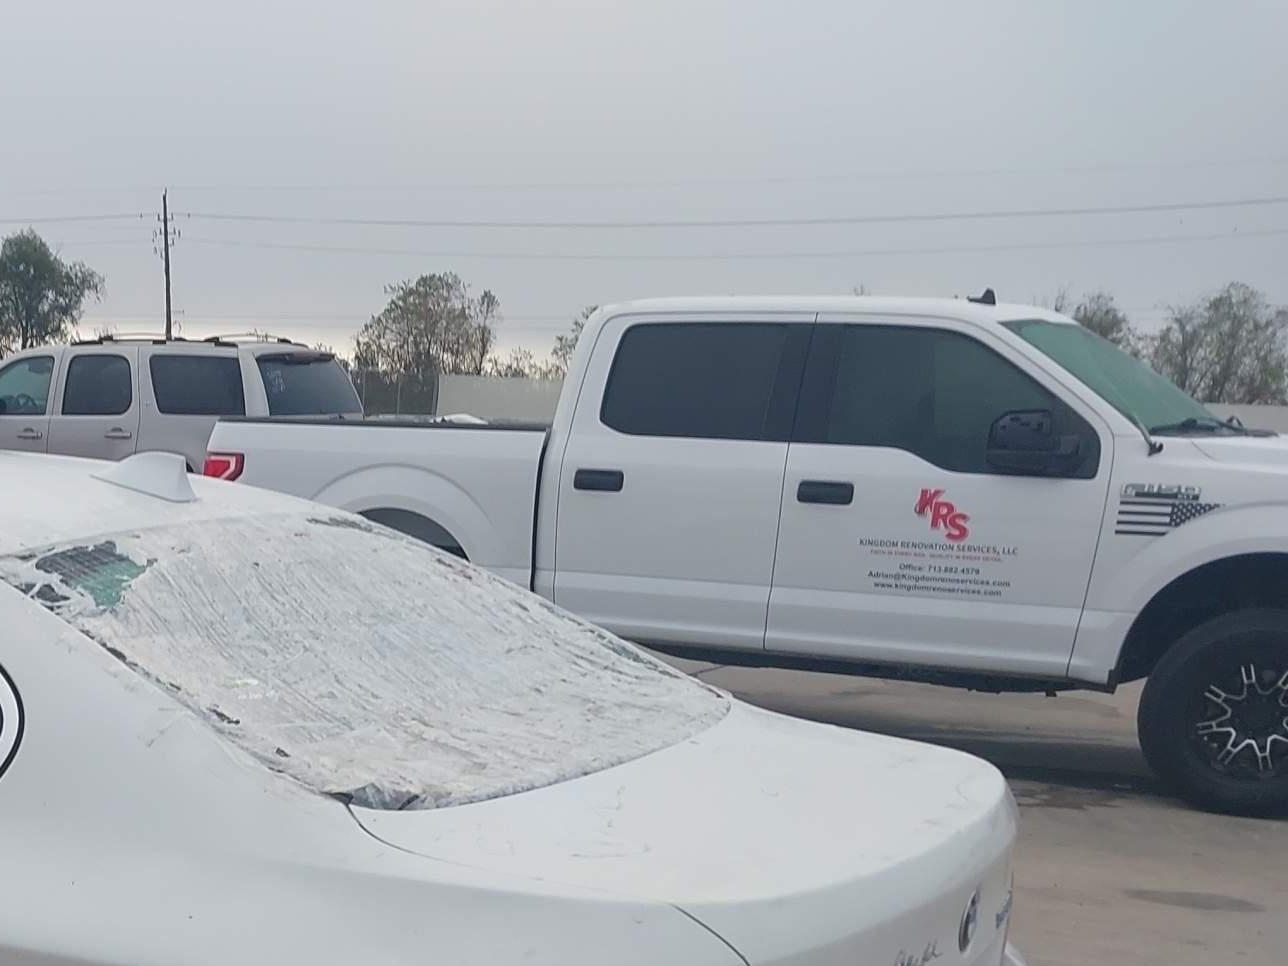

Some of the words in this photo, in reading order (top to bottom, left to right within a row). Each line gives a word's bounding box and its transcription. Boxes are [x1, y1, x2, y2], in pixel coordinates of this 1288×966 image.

[915, 488, 969, 540] KRS
[859, 538, 899, 548] KINGDOM
[900, 540, 954, 551] RENOVATION
[956, 544, 1000, 555] SERVICES,
[1002, 546, 1018, 555] LLC
